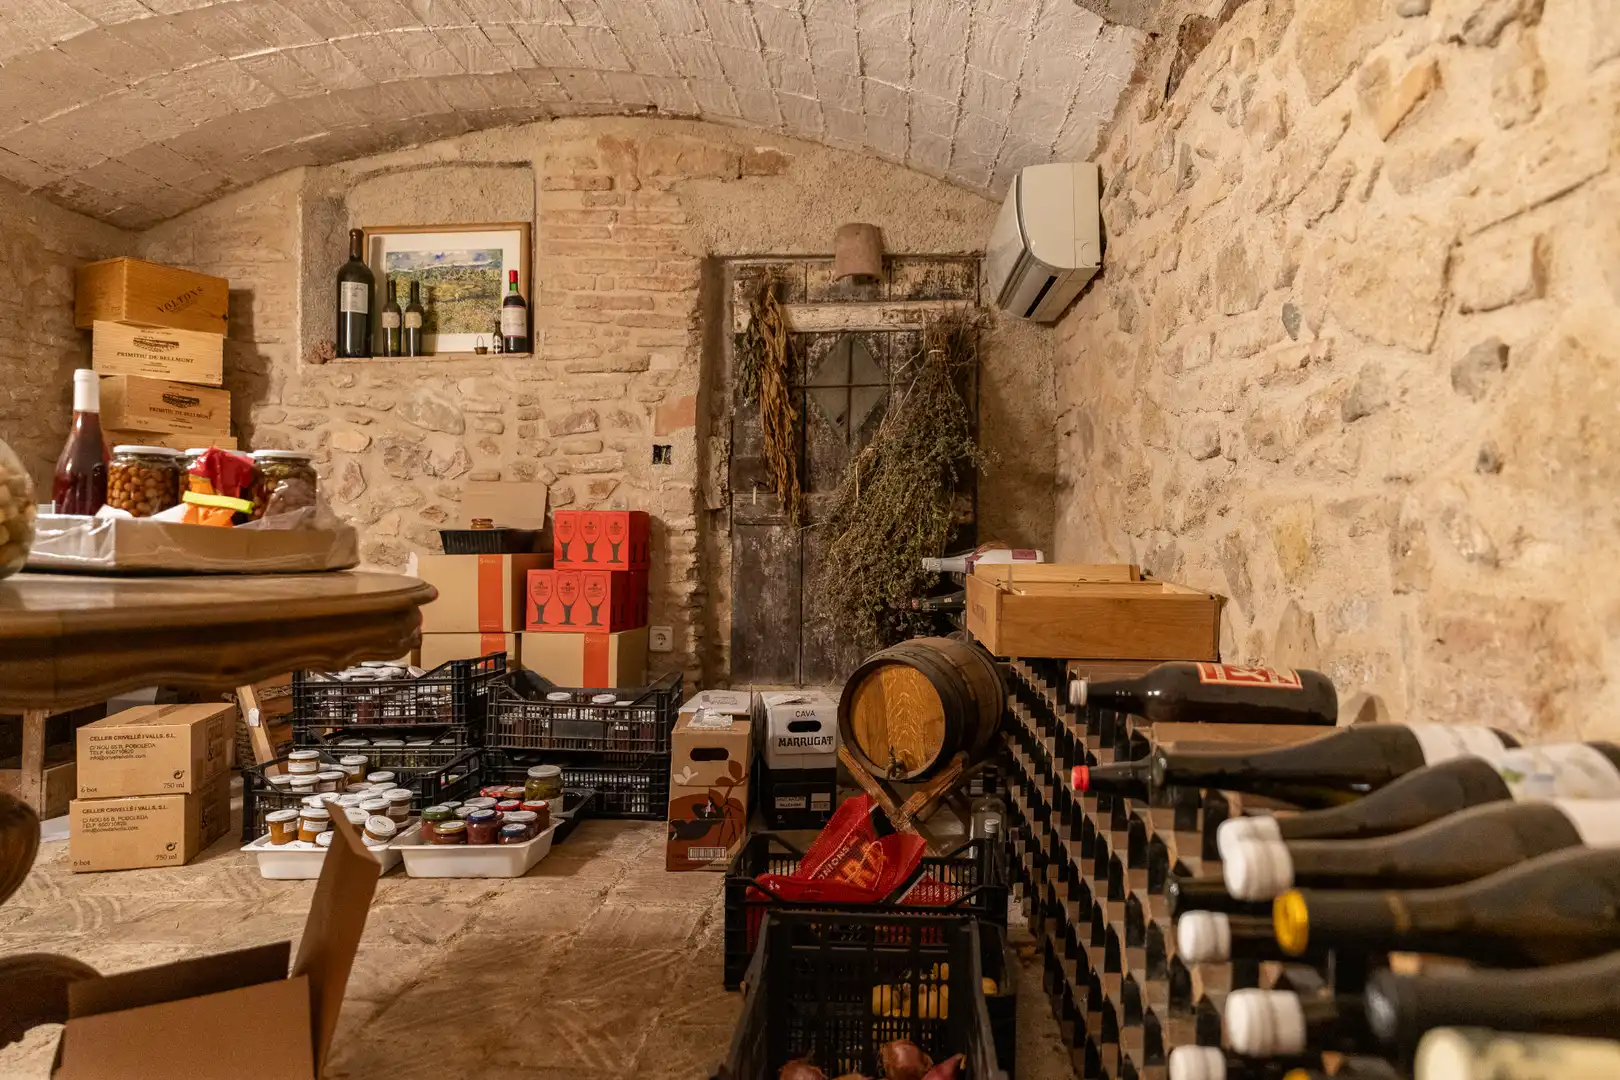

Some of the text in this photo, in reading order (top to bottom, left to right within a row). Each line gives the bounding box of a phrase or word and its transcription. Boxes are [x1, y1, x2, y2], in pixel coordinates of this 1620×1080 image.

[159, 355, 195, 364] BELLMUNT
[795, 710, 816, 718] CAVA
[777, 735, 834, 748] MARRUGAT
[176, 781, 185, 789] ml
[105, 805, 134, 813] CRIVELLÉ
